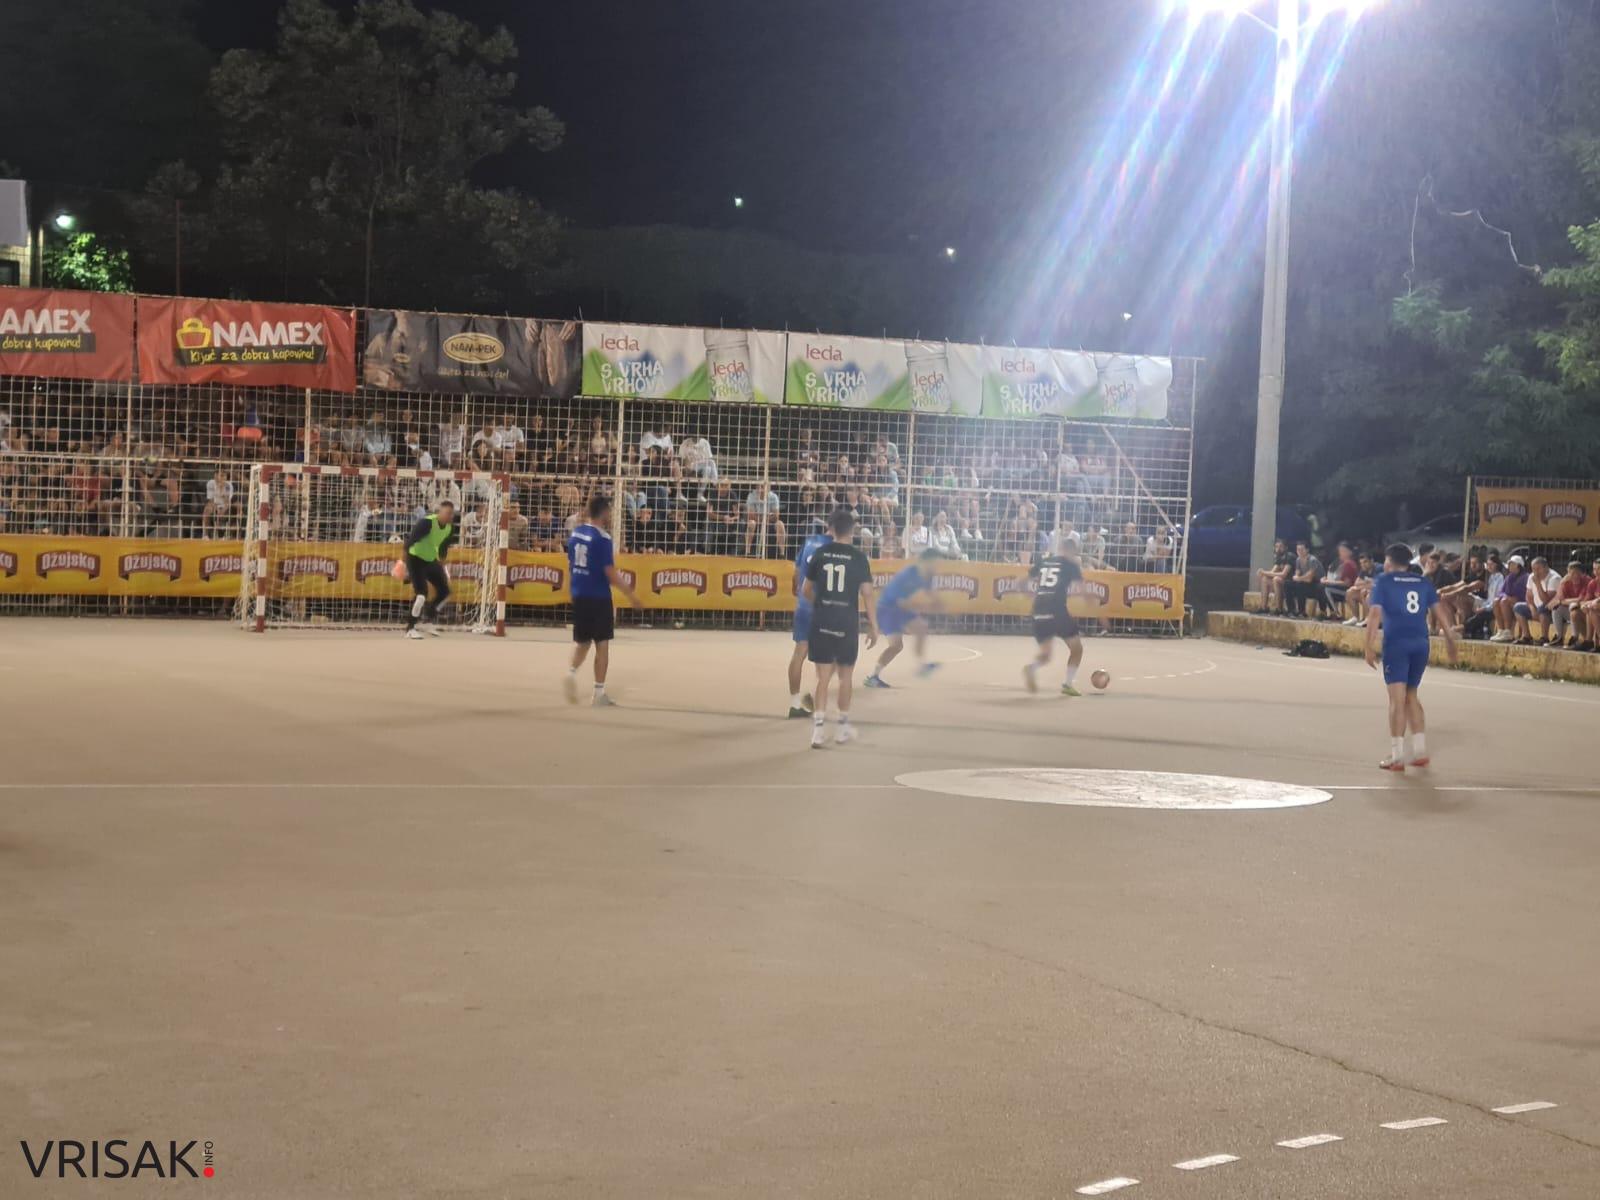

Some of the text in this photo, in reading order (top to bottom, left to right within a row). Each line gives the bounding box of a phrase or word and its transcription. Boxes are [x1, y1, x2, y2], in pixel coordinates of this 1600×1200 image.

[2, 336, 32, 349] dobru
[213, 321, 323, 347] NAMEX
[601, 334, 640, 351] leda
[222, 352, 238, 361] za
[241, 347, 269, 361] dobru
[805, 344, 843, 361] leda
[601, 360, 664, 379] S VRHA
[713, 360, 745, 375] leda
[1000, 357, 1035, 373] leda
[805, 371, 867, 388] S VRHA
[914, 371, 944, 386] leda
[1000, 384, 1010, 399] S
[42, 551, 95, 570] Ožujsko
[124, 553, 176, 572] Ožujsko
[511, 566, 559, 583] Ožujsko
[657, 570, 702, 587] Ožujsko
[727, 573, 772, 589] Ožujsko
[823, 563, 845, 592] 11
[1040, 567, 1060, 587] 15
[1128, 584, 1168, 601] Ožujsko
[1407, 590, 1419, 614] 8
